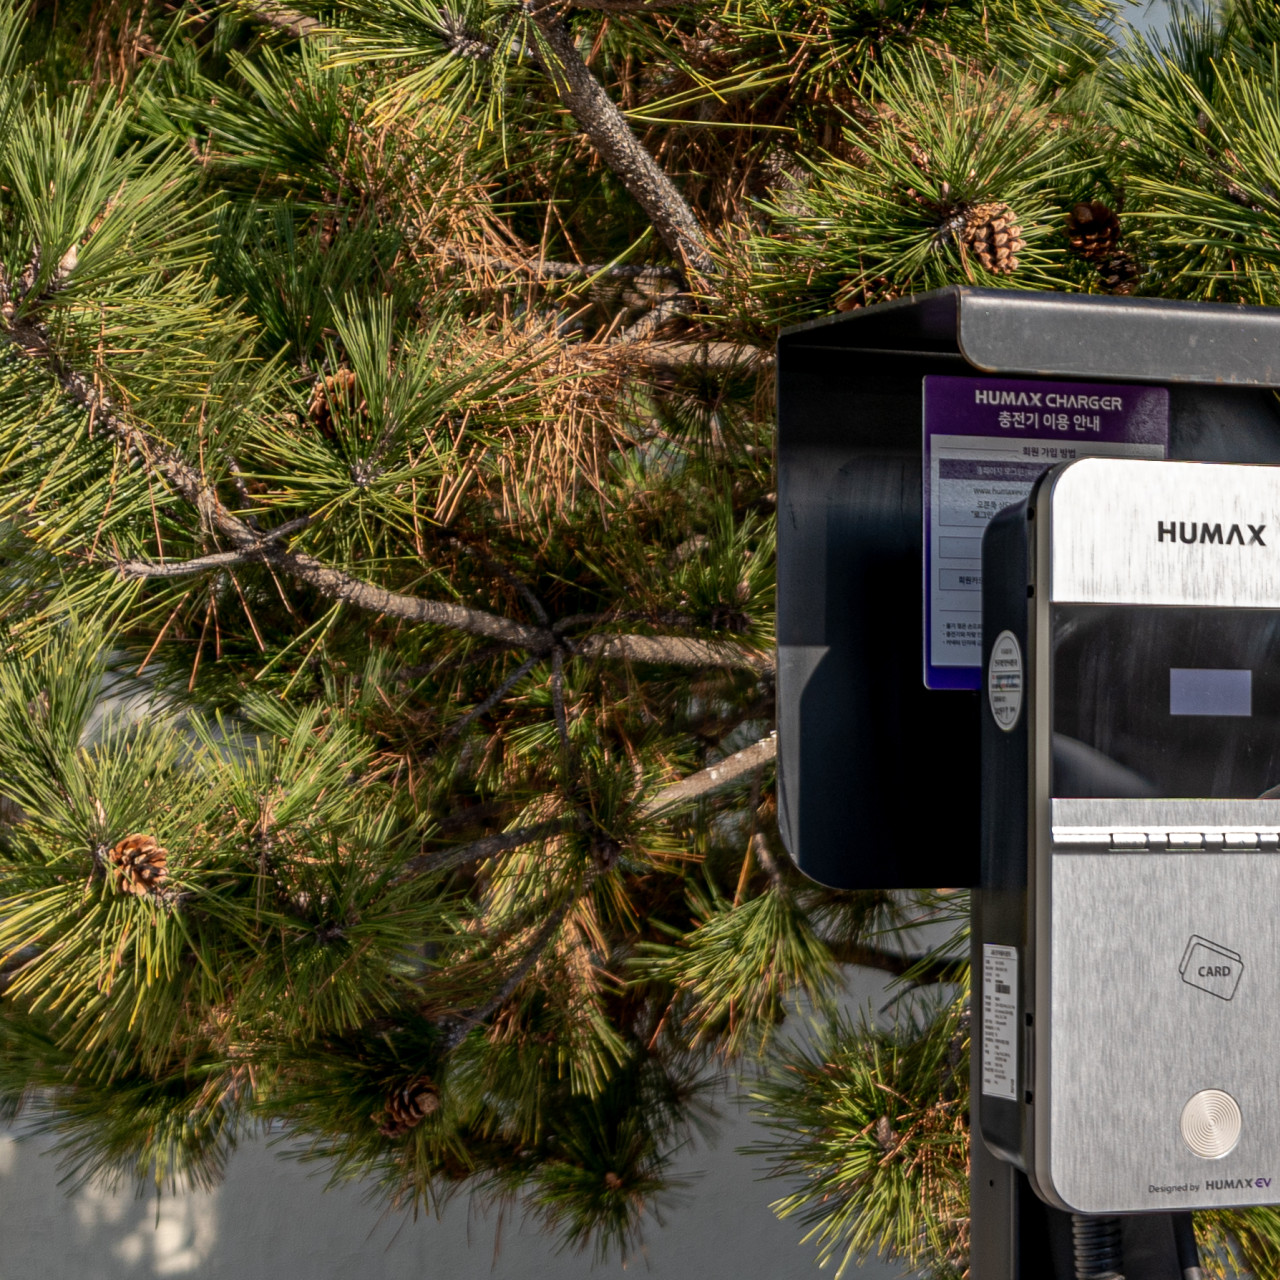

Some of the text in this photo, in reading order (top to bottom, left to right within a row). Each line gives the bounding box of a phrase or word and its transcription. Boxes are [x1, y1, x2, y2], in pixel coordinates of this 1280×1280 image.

[975, 389, 1122, 411] HUMAX CHARGER
[998, 410, 1100, 432] 충전기 이용 안내
[1022, 446, 1076, 459] 회원 가입 방법
[1157, 520, 1267, 547] HUMAX
[1198, 965, 1231, 977] CARD
[1148, 1183, 1188, 1194] Designed
[1189, 1182, 1200, 1192] by
[1205, 1179, 1253, 1190] HUMAX
